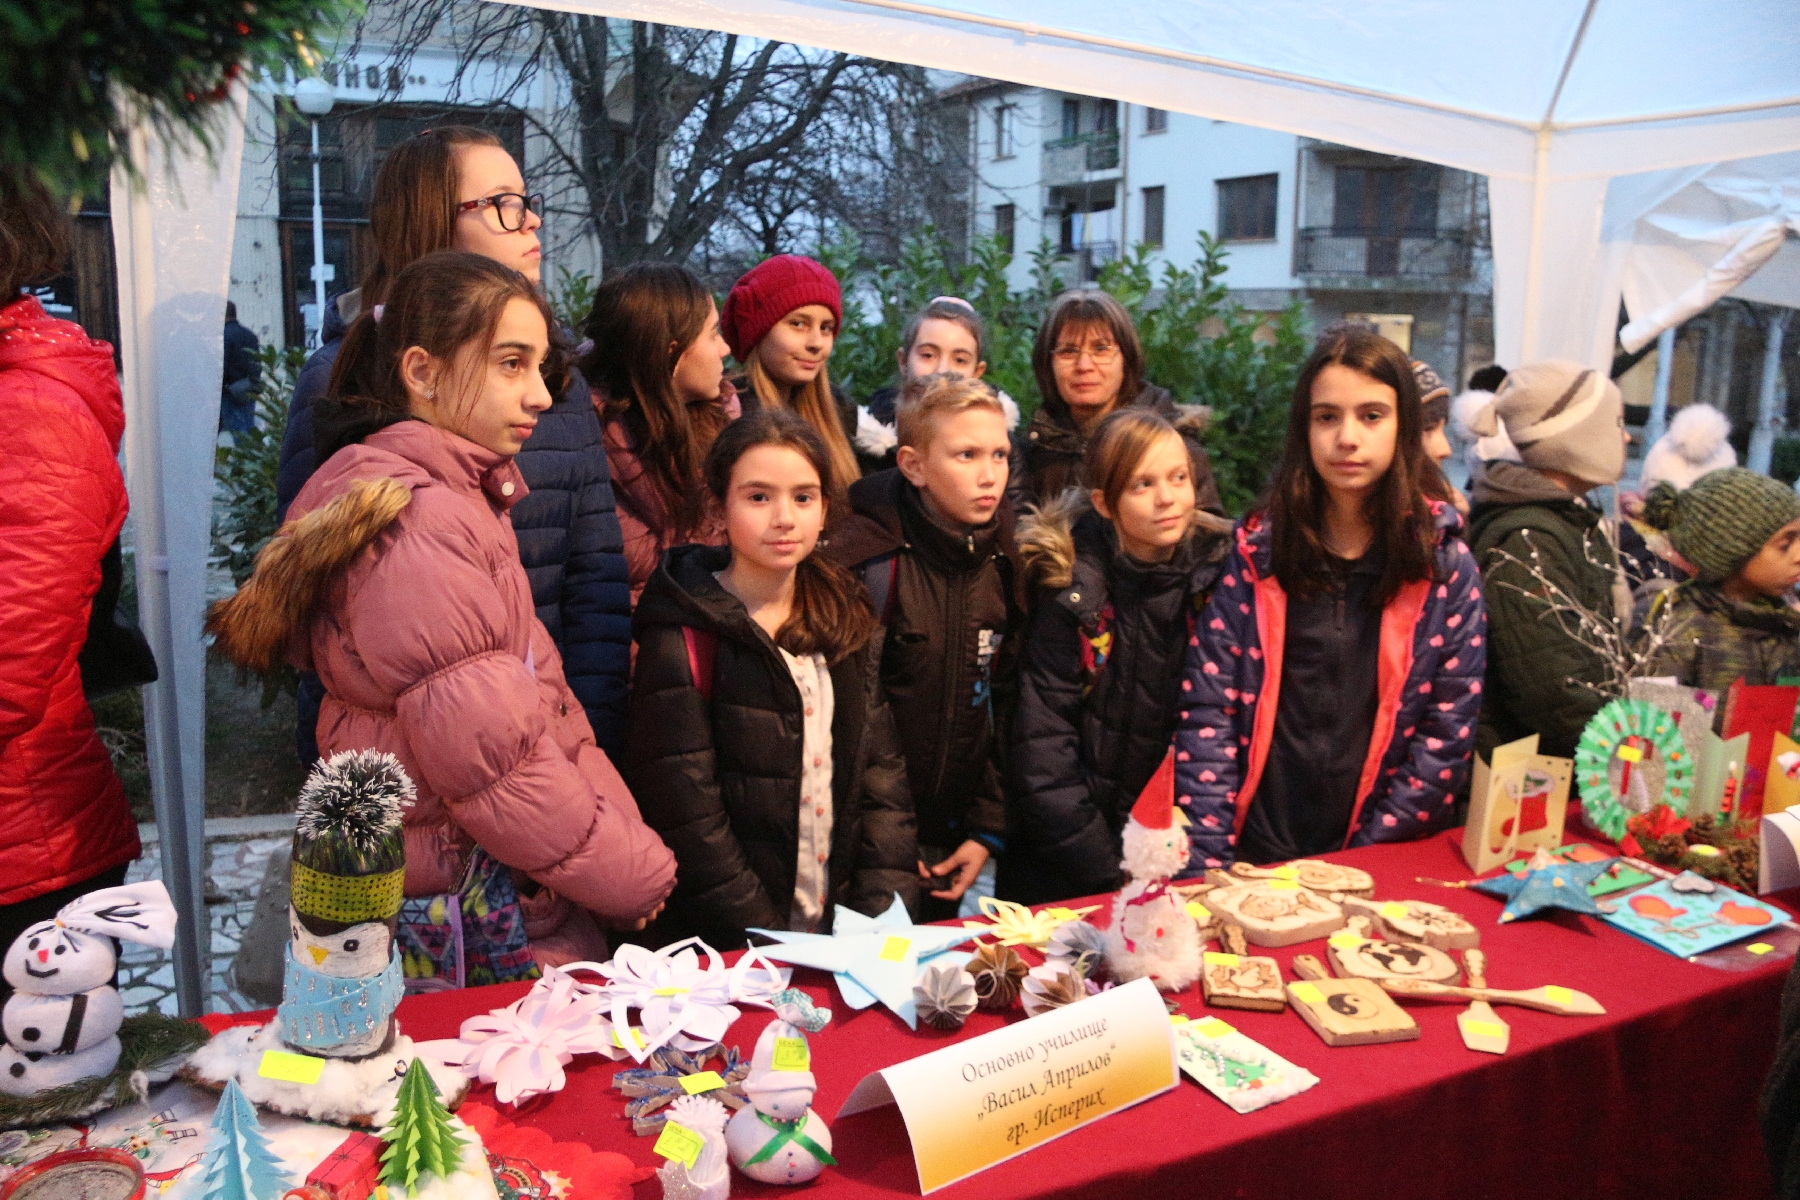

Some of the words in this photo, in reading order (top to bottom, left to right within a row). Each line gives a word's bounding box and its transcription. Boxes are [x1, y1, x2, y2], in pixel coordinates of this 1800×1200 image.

[962, 1046, 1034, 1082] Основно
[1039, 1018, 1108, 1062] училище
[977, 1083, 1037, 1121] „Васил
[1041, 1040, 1116, 1095] Априлов“
[1007, 1122, 1029, 1145] гр.
[1034, 1088, 1106, 1130] Исперих
